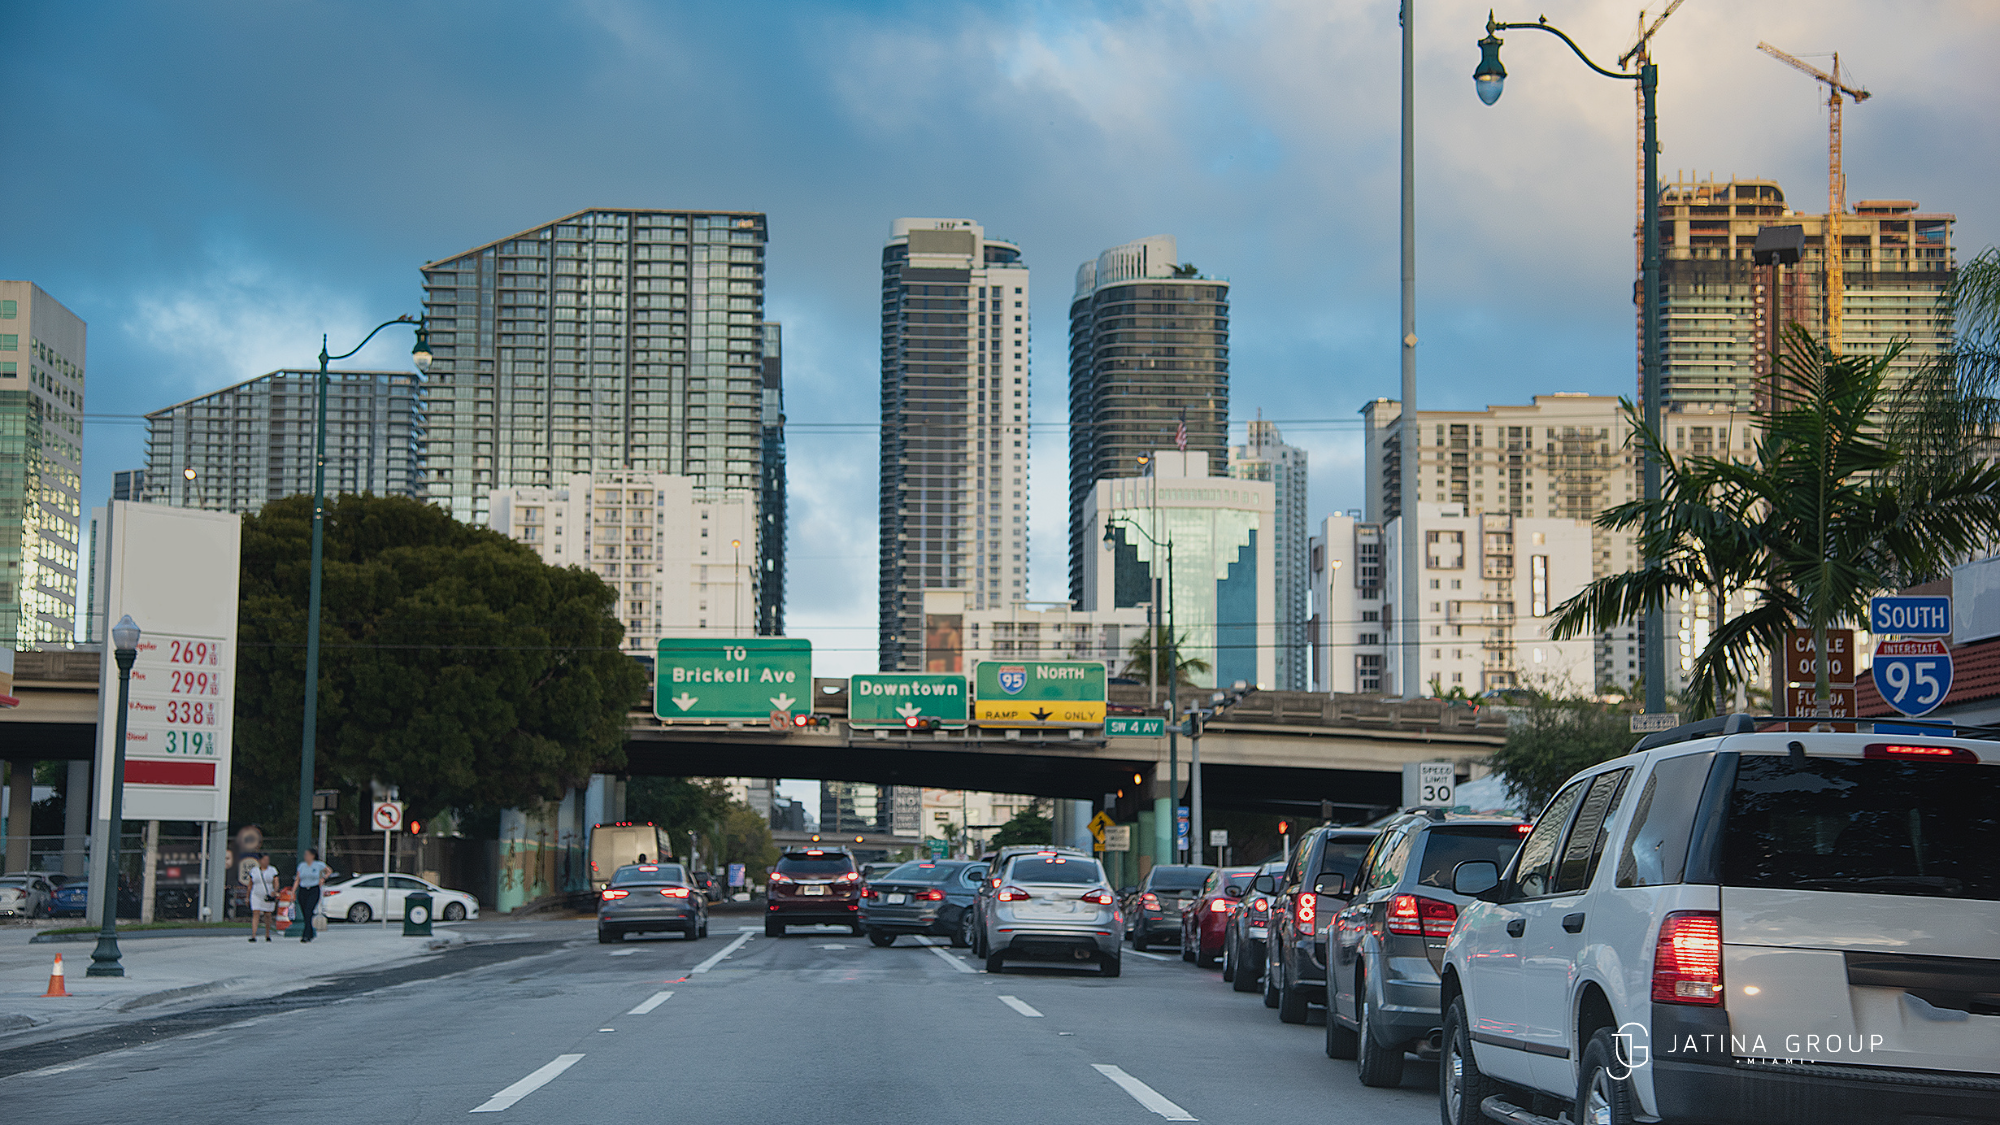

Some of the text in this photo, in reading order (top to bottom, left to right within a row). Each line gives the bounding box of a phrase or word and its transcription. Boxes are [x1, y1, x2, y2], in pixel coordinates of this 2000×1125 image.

[1877, 603, 1945, 629] SOUTH
[170, 640, 207, 665] 269
[1795, 637, 1845, 653] CALE
[1883, 642, 1939, 655] INTERSTATE
[723, 646, 747, 661] TO
[672, 667, 796, 683] Brickell Ave
[1036, 664, 1085, 680] NORTH
[171, 670, 208, 695] 299
[860, 680, 958, 696] Downtown
[1001, 674, 1023, 688] 95
[1885, 661, 1940, 705] 95
[166, 700, 204, 724] 338
[985, 711, 1096, 720] RAMP ONLY
[1111, 721, 1159, 733] SW 4 AV
[165, 730, 204, 755] 319
[1422, 766, 1453, 775] SPEED
[1425, 776, 1448, 784] LIMIT
[1423, 785, 1451, 802] 30
